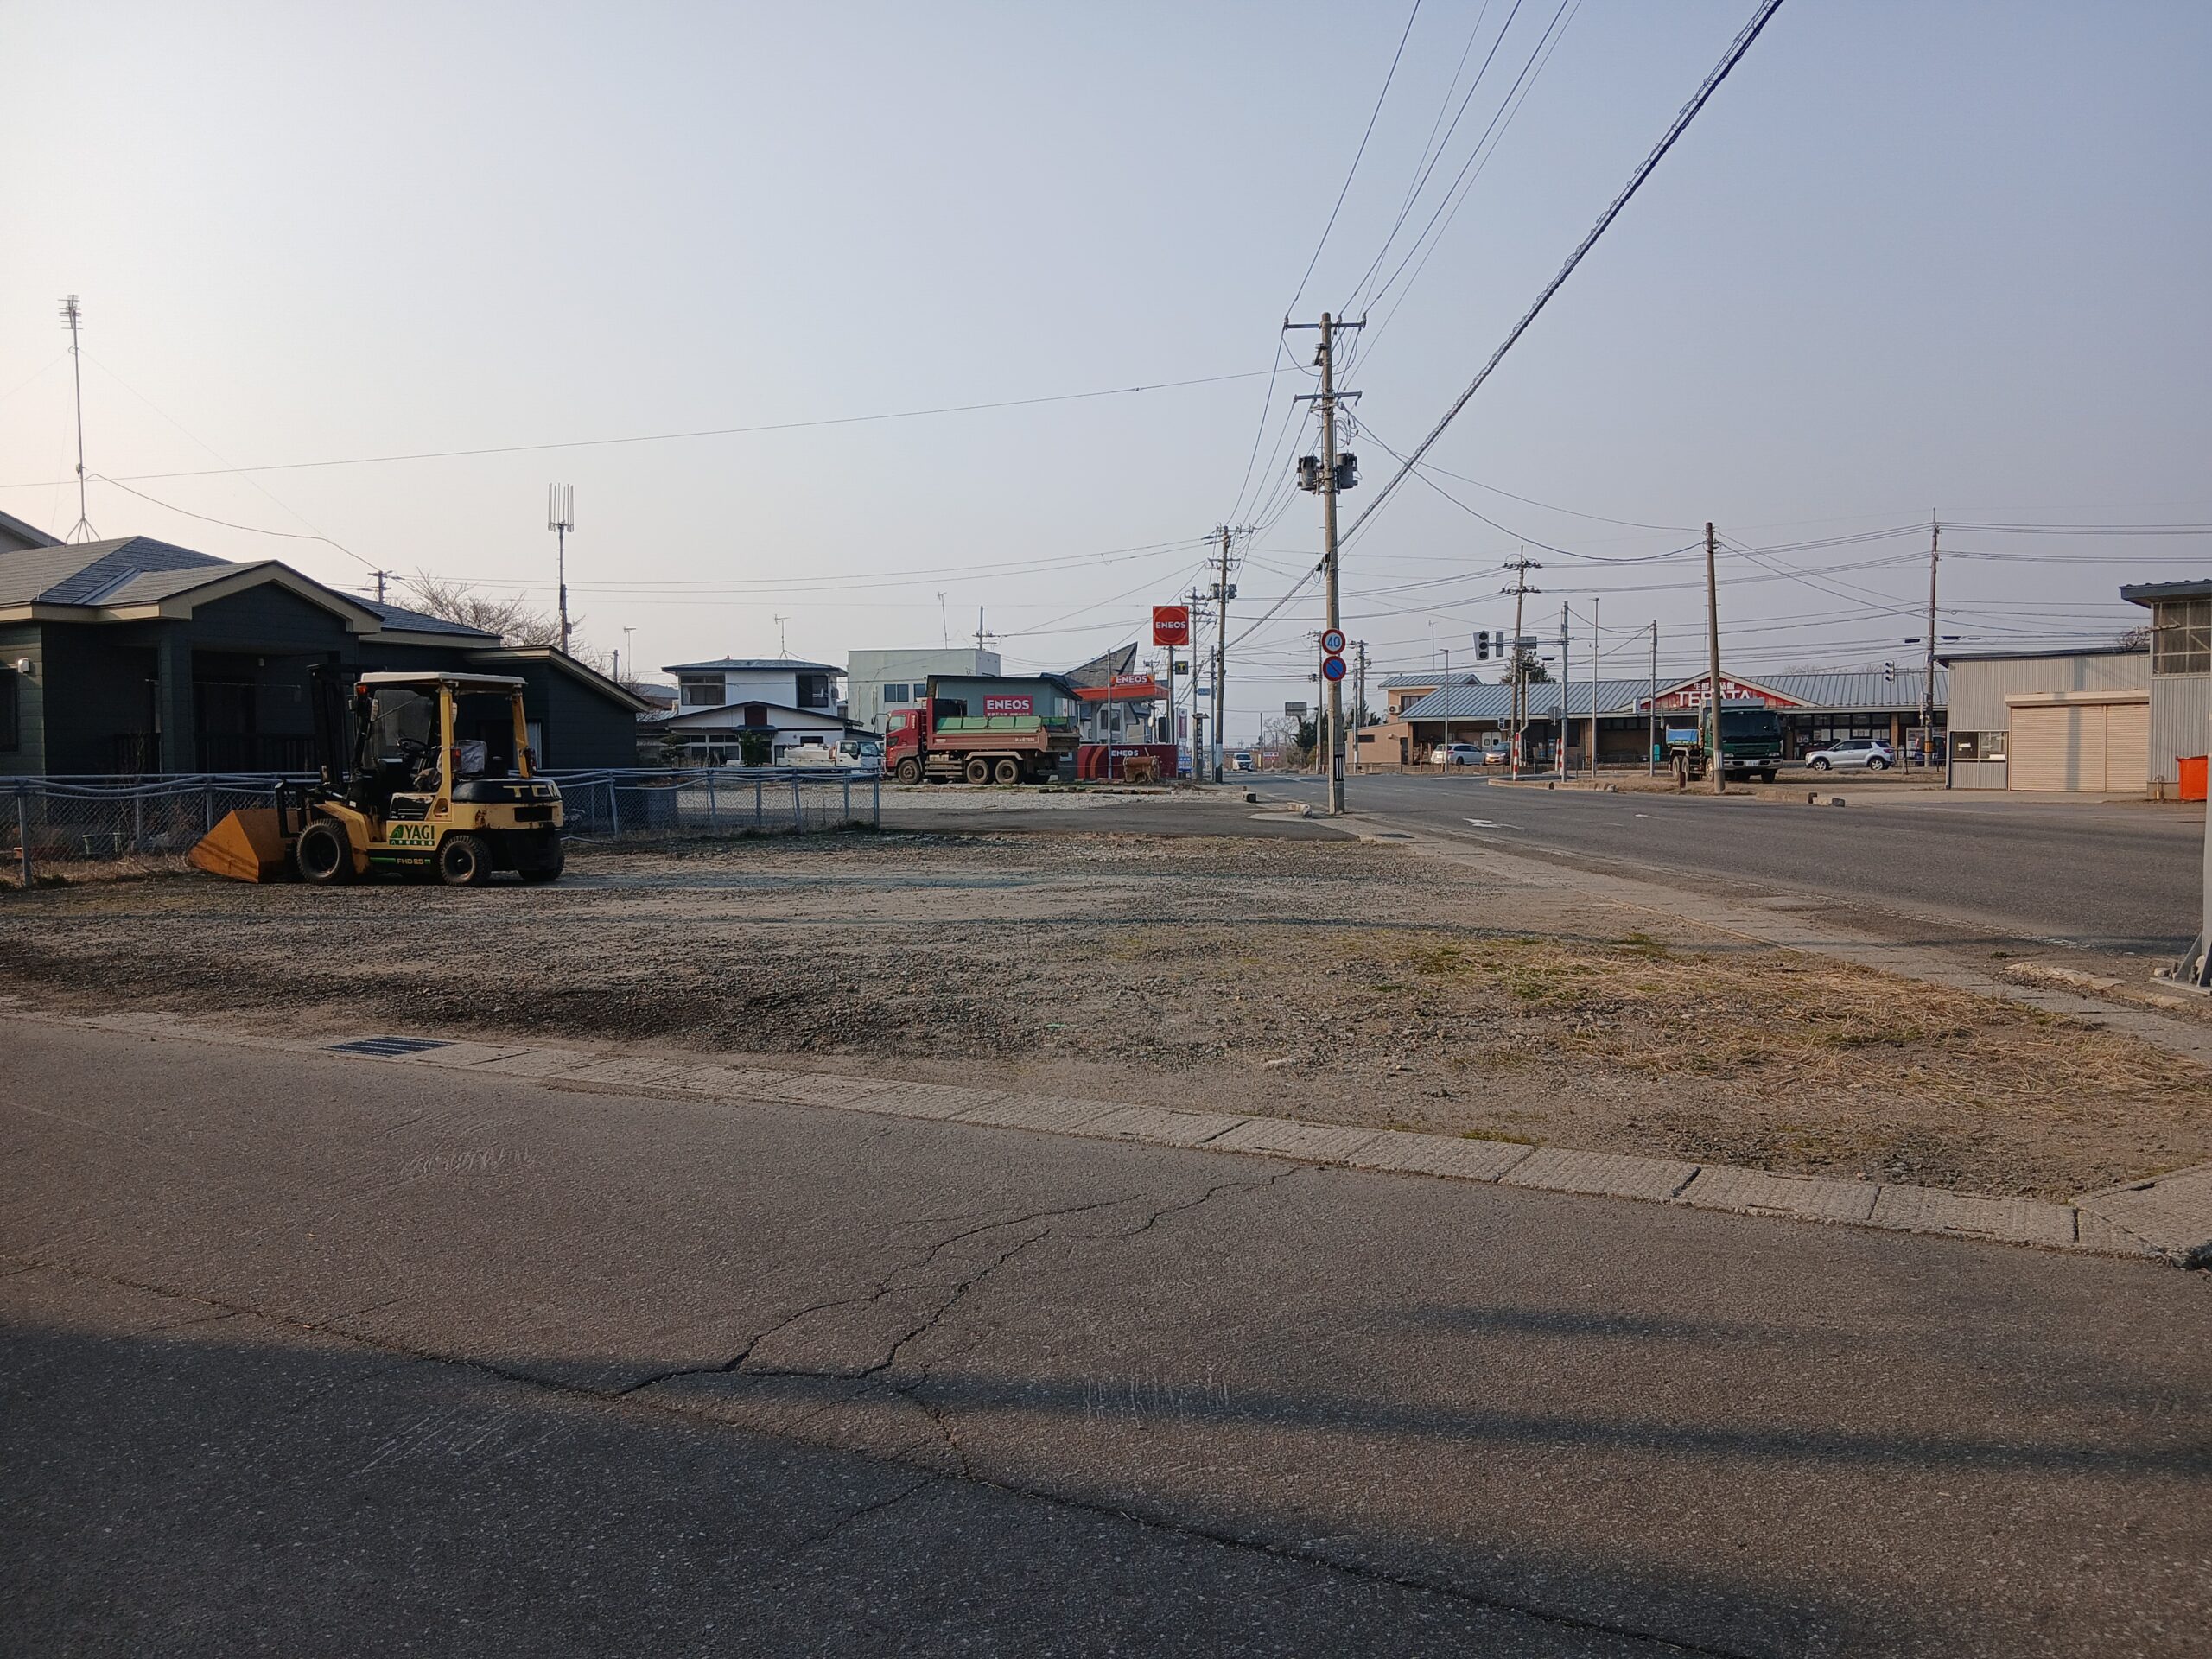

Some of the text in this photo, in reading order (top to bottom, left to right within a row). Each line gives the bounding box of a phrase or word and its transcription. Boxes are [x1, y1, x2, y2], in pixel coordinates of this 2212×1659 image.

[1327, 636, 1341, 647] 40
[1116, 675, 1147, 683] ENEOS
[1694, 682, 1735, 690] 生鮮品館
[987, 699, 1030, 710] ENEOS
[404, 824, 435, 839] YAGI
